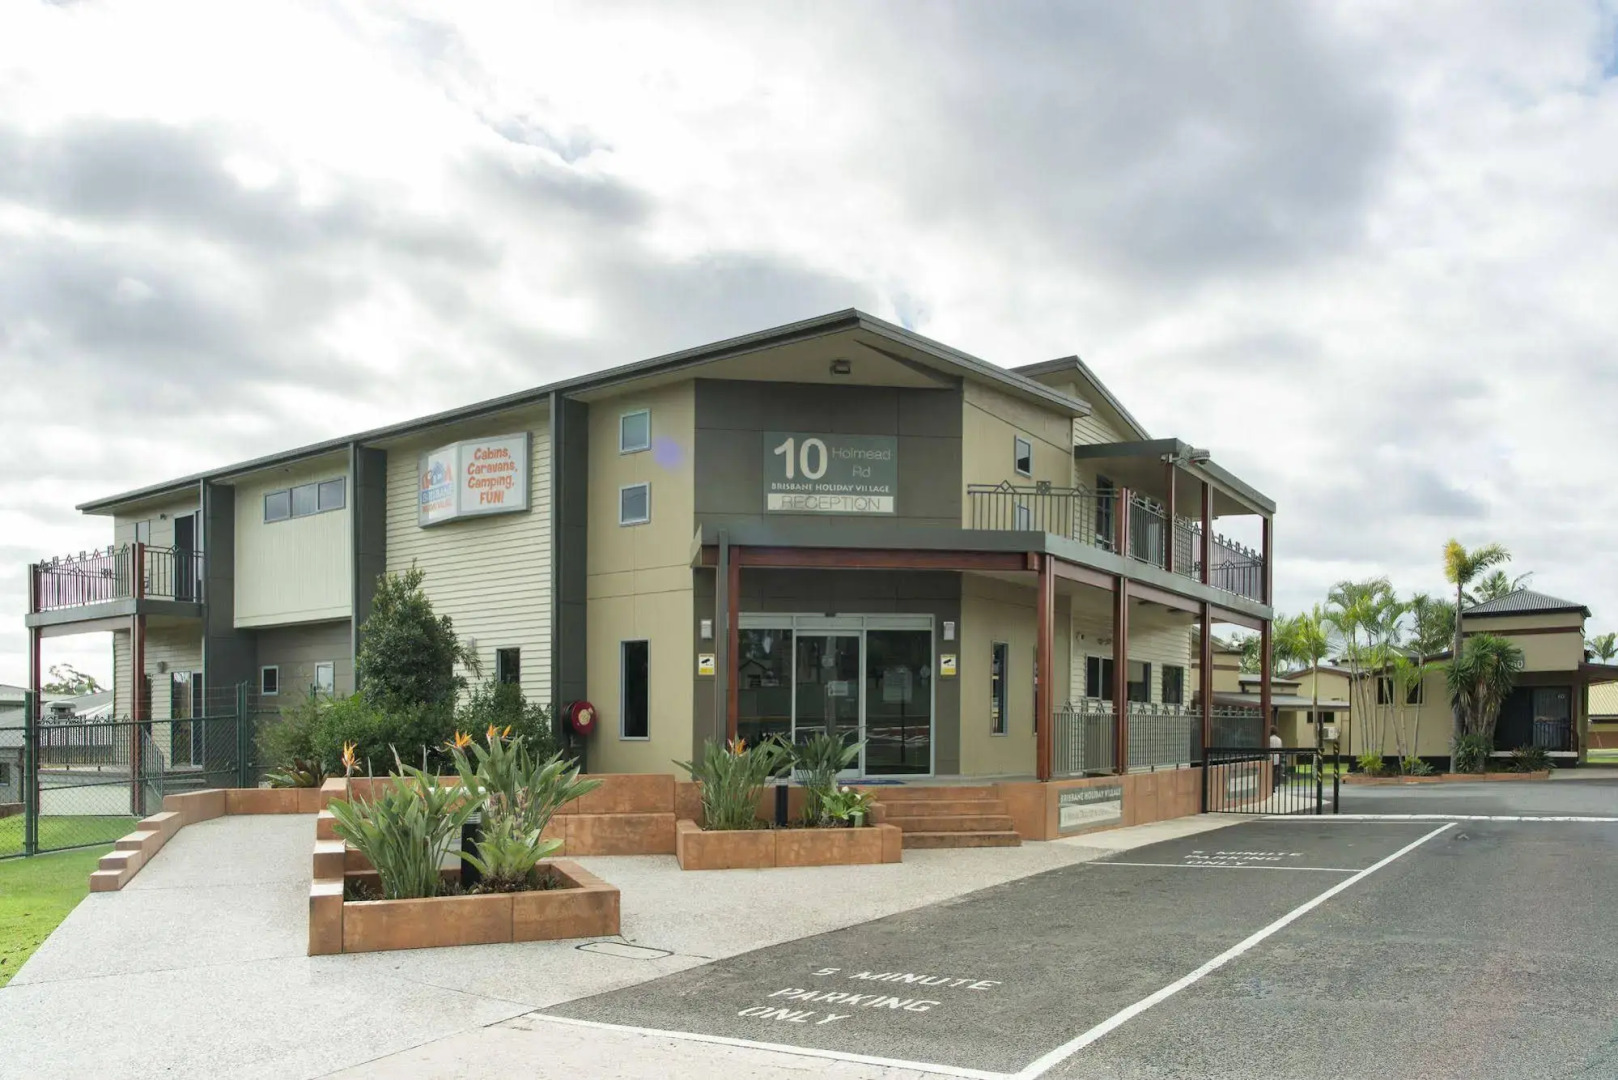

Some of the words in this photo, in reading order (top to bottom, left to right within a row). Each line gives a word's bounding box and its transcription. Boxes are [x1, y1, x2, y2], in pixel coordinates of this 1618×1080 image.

[474, 447, 511, 460] Cabins,
[774, 437, 828, 480] 10
[832, 447, 891, 460] Holmead
[467, 461, 518, 475] Caravans,
[852, 465, 871, 478] Rd
[467, 475, 515, 489] Camping,
[771, 482, 812, 491] BRISBANE
[815, 483, 853, 492] HOLIDAY
[856, 485, 889, 493] VILLAGE
[781, 495, 880, 511] RECEPTION
[812, 967, 841, 976] 5
[849, 971, 1002, 990] MINUTE
[767, 987, 941, 1012] PARKING
[737, 1006, 851, 1025] ONLY
